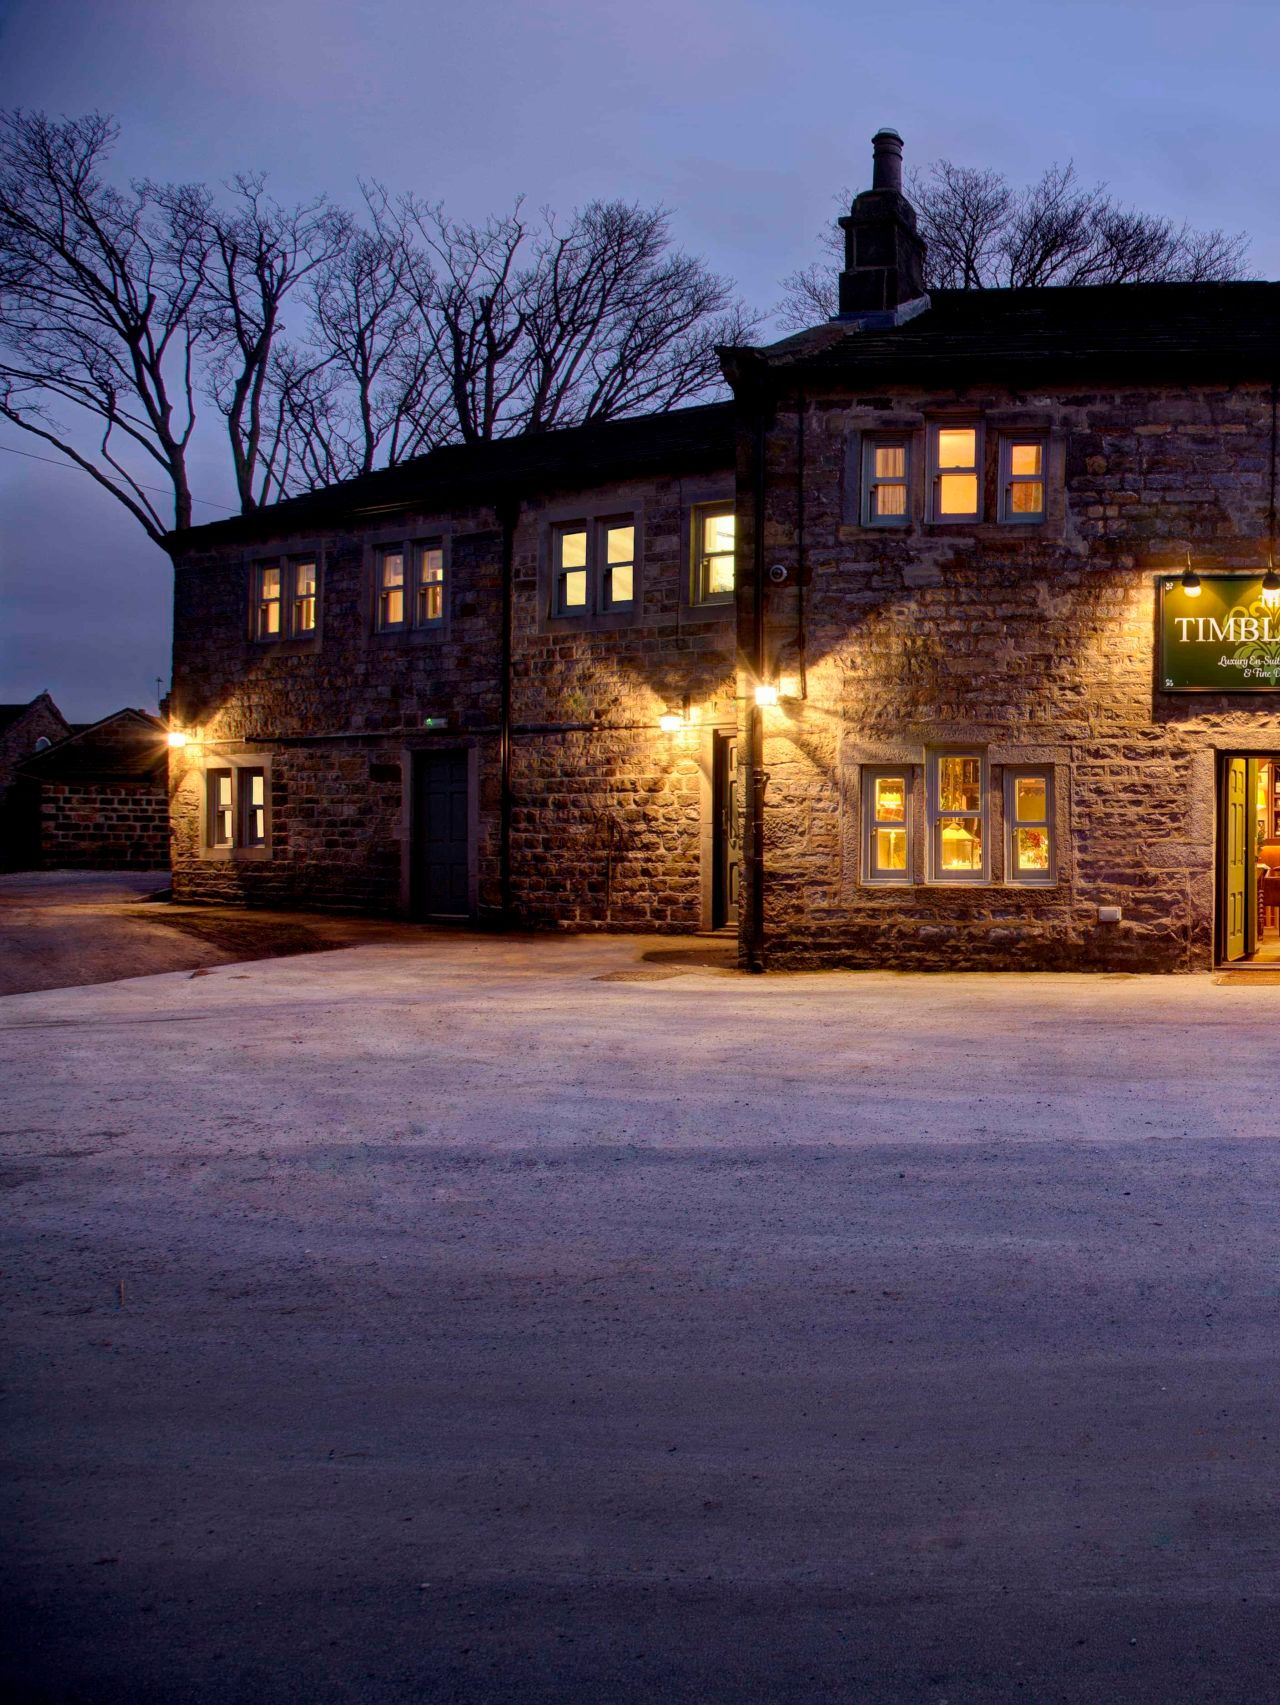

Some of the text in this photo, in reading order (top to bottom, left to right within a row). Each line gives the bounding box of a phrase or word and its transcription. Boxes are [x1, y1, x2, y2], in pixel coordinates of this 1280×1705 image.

[1218, 655, 1248, 668] Luxury
[1244, 668, 1252, 678] &
[1253, 668, 1271, 678] Fine
